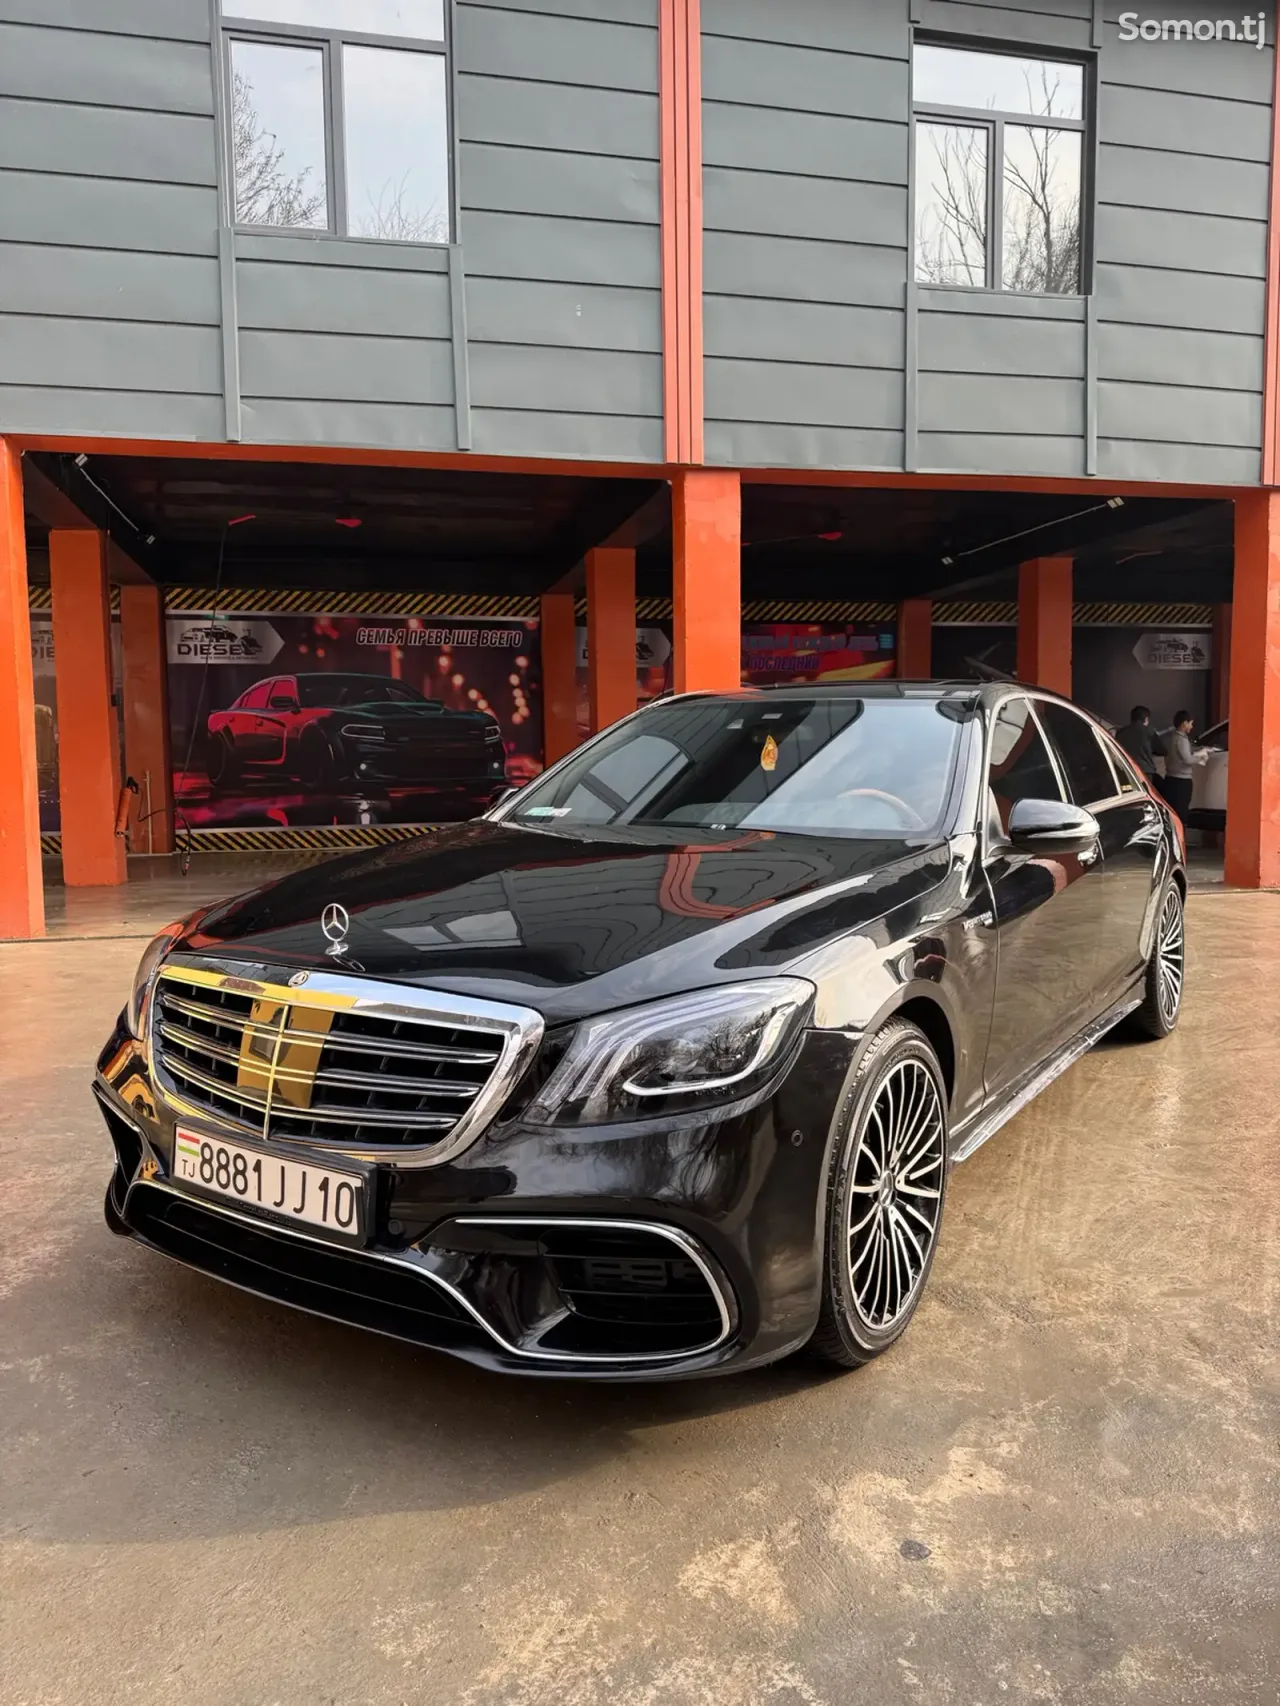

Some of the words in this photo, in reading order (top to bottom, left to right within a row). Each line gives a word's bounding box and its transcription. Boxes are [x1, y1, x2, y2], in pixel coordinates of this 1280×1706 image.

[356, 627, 407, 645] СЕМЬЯ
[408, 629, 478, 646] ПРЕВЫШЕ
[479, 630, 523, 647] ВСЕГО
[182, 1158, 197, 1178] TJ
